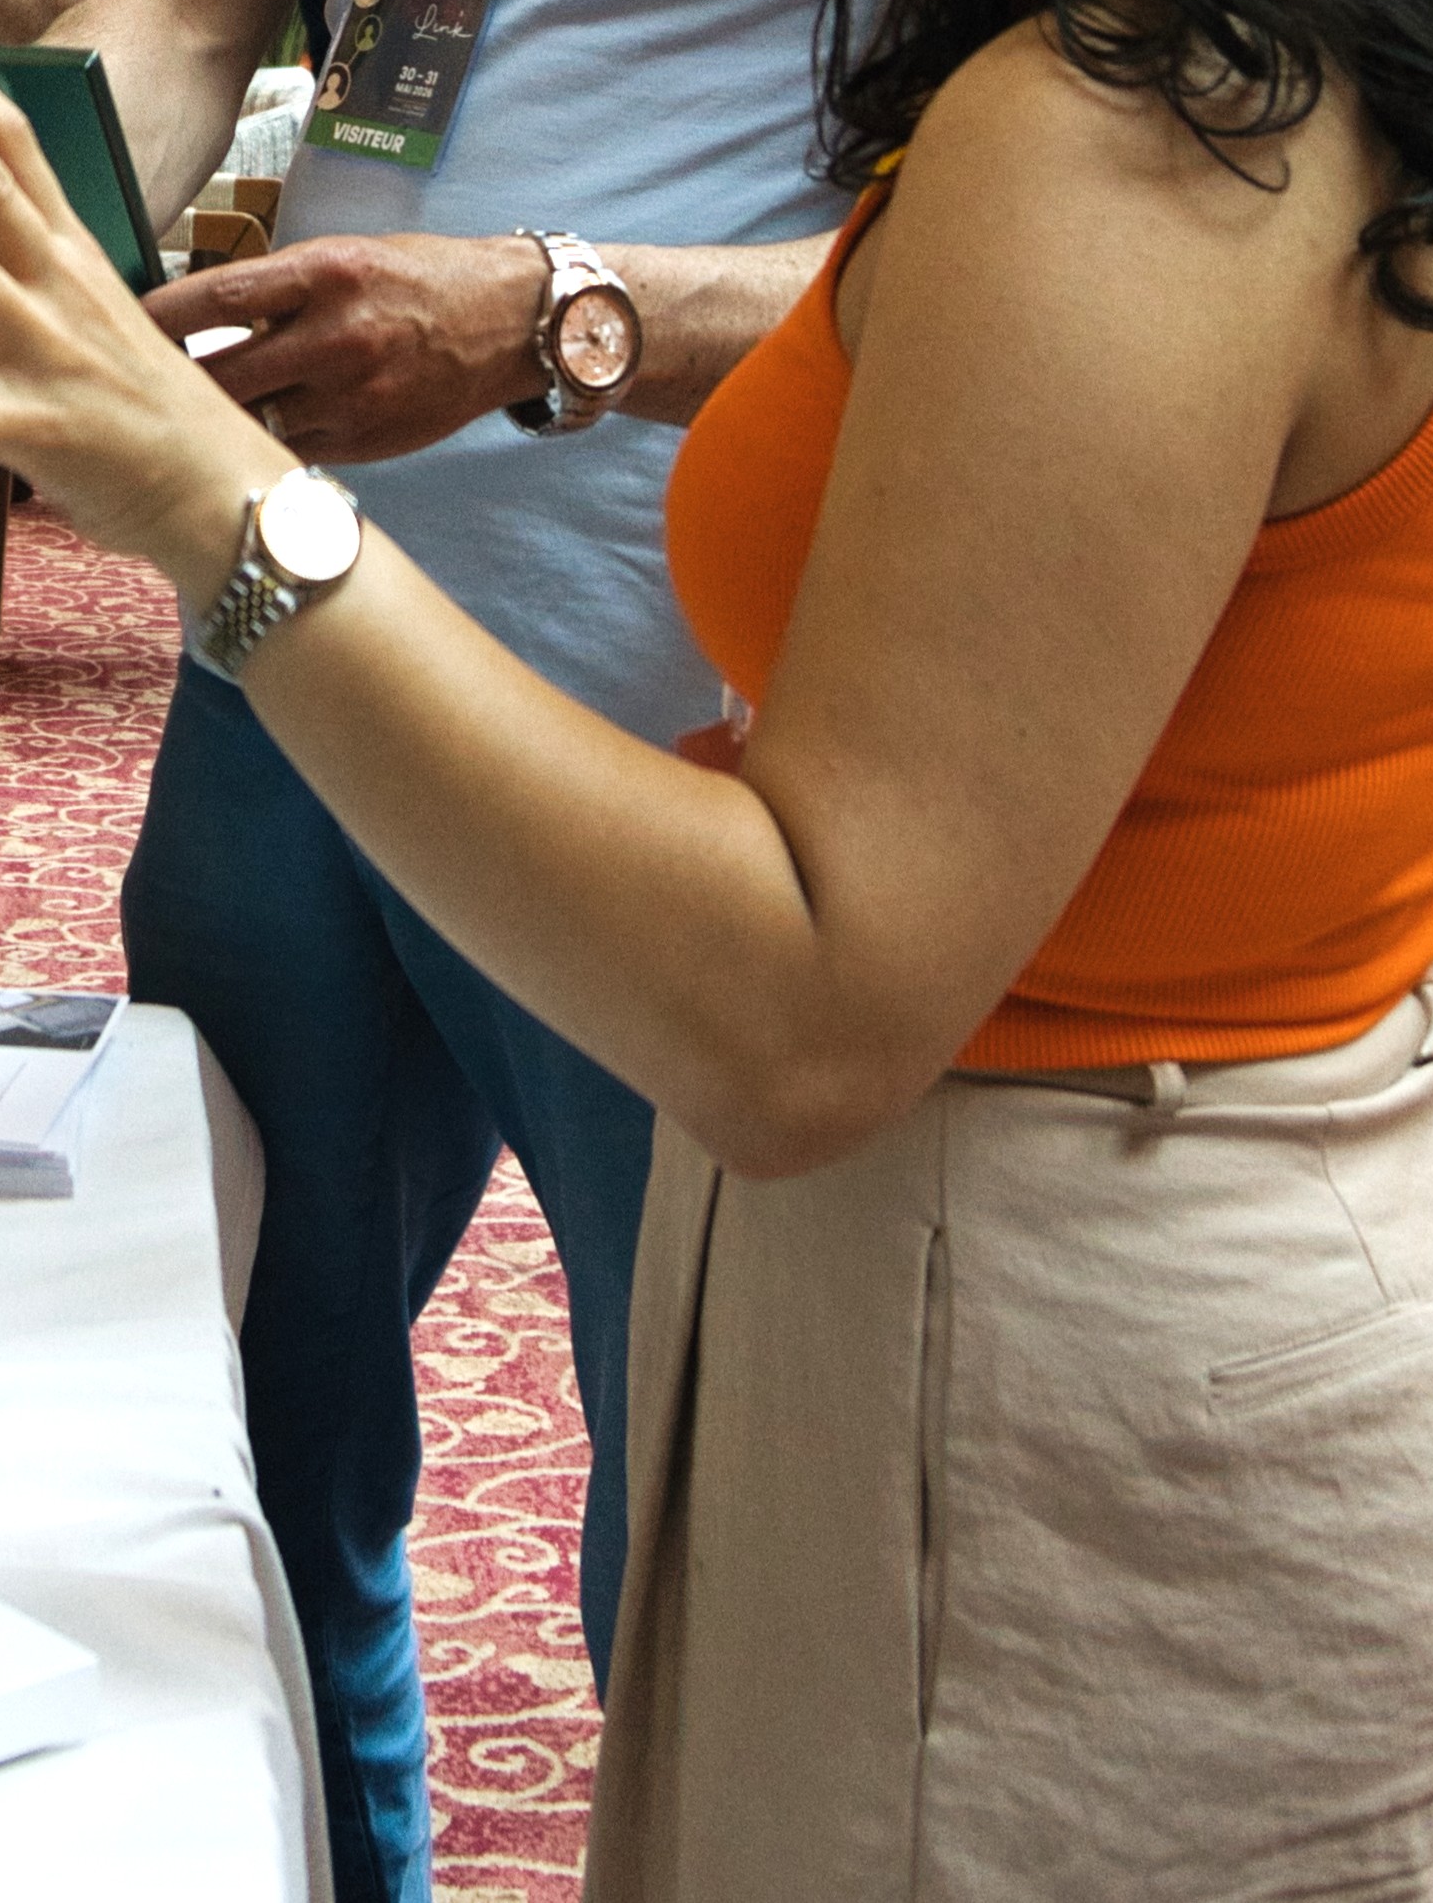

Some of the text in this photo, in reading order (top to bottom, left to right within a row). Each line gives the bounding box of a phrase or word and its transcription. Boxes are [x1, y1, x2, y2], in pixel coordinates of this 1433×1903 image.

[399, 65, 416, 81] 30
[424, 69, 439, 86] 31
[333, 120, 406, 154] VISITEUR
